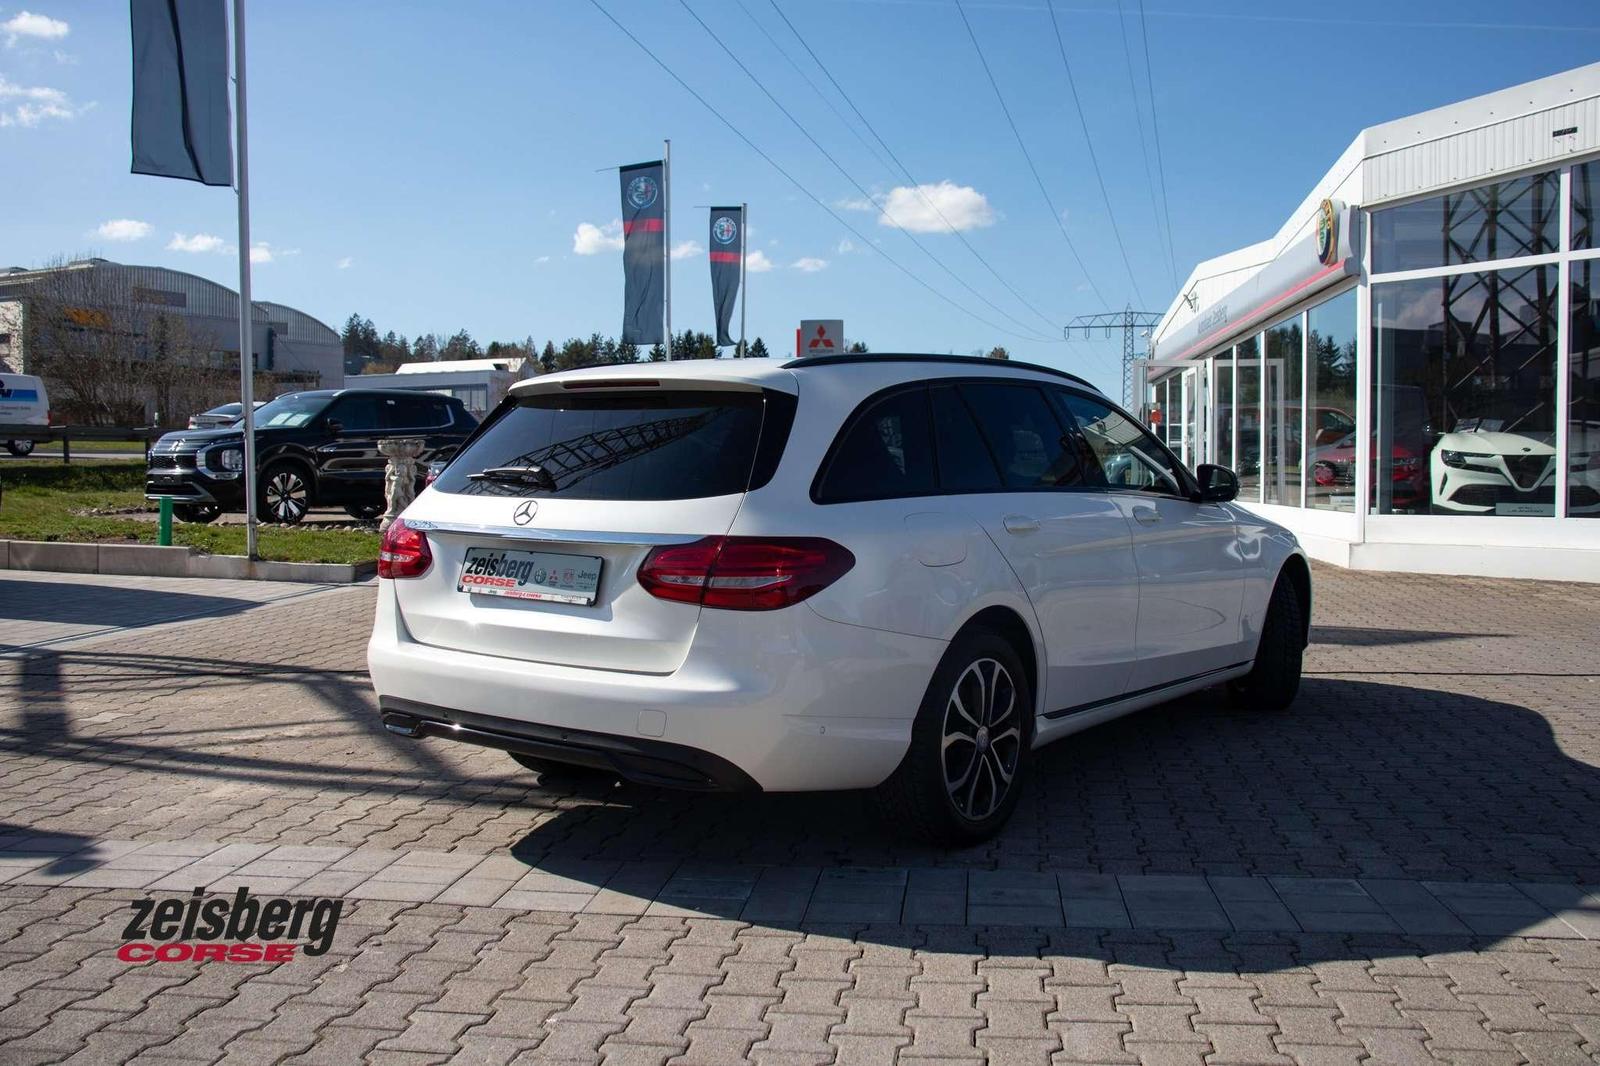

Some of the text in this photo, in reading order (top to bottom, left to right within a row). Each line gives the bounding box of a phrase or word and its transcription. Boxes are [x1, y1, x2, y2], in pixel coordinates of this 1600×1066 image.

[466, 553, 534, 586] zeisberg
[578, 570, 597, 581] Jeep
[462, 575, 516, 587] CORSE
